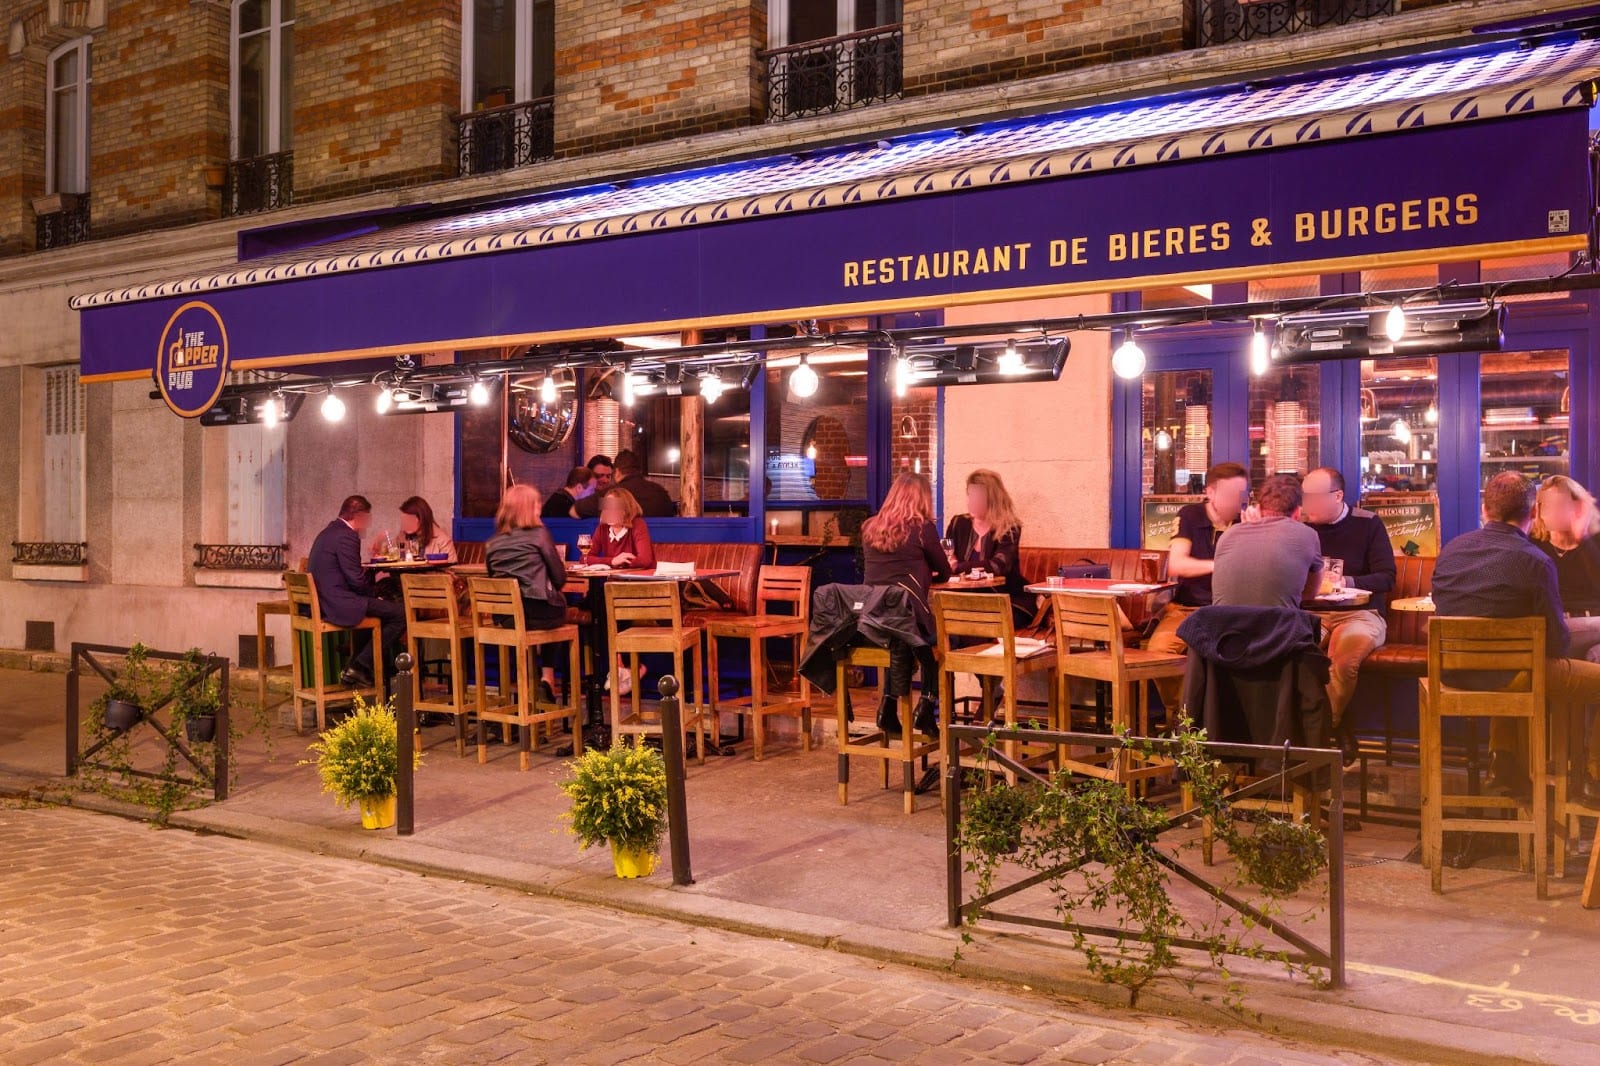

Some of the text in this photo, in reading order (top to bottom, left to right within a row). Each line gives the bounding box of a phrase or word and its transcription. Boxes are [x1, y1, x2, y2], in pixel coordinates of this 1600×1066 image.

[843, 193, 1478, 287] RESTAURANT DE BIERES & BURGERS
[185, 331, 205, 347] THE
[168, 371, 193, 391] PUB
